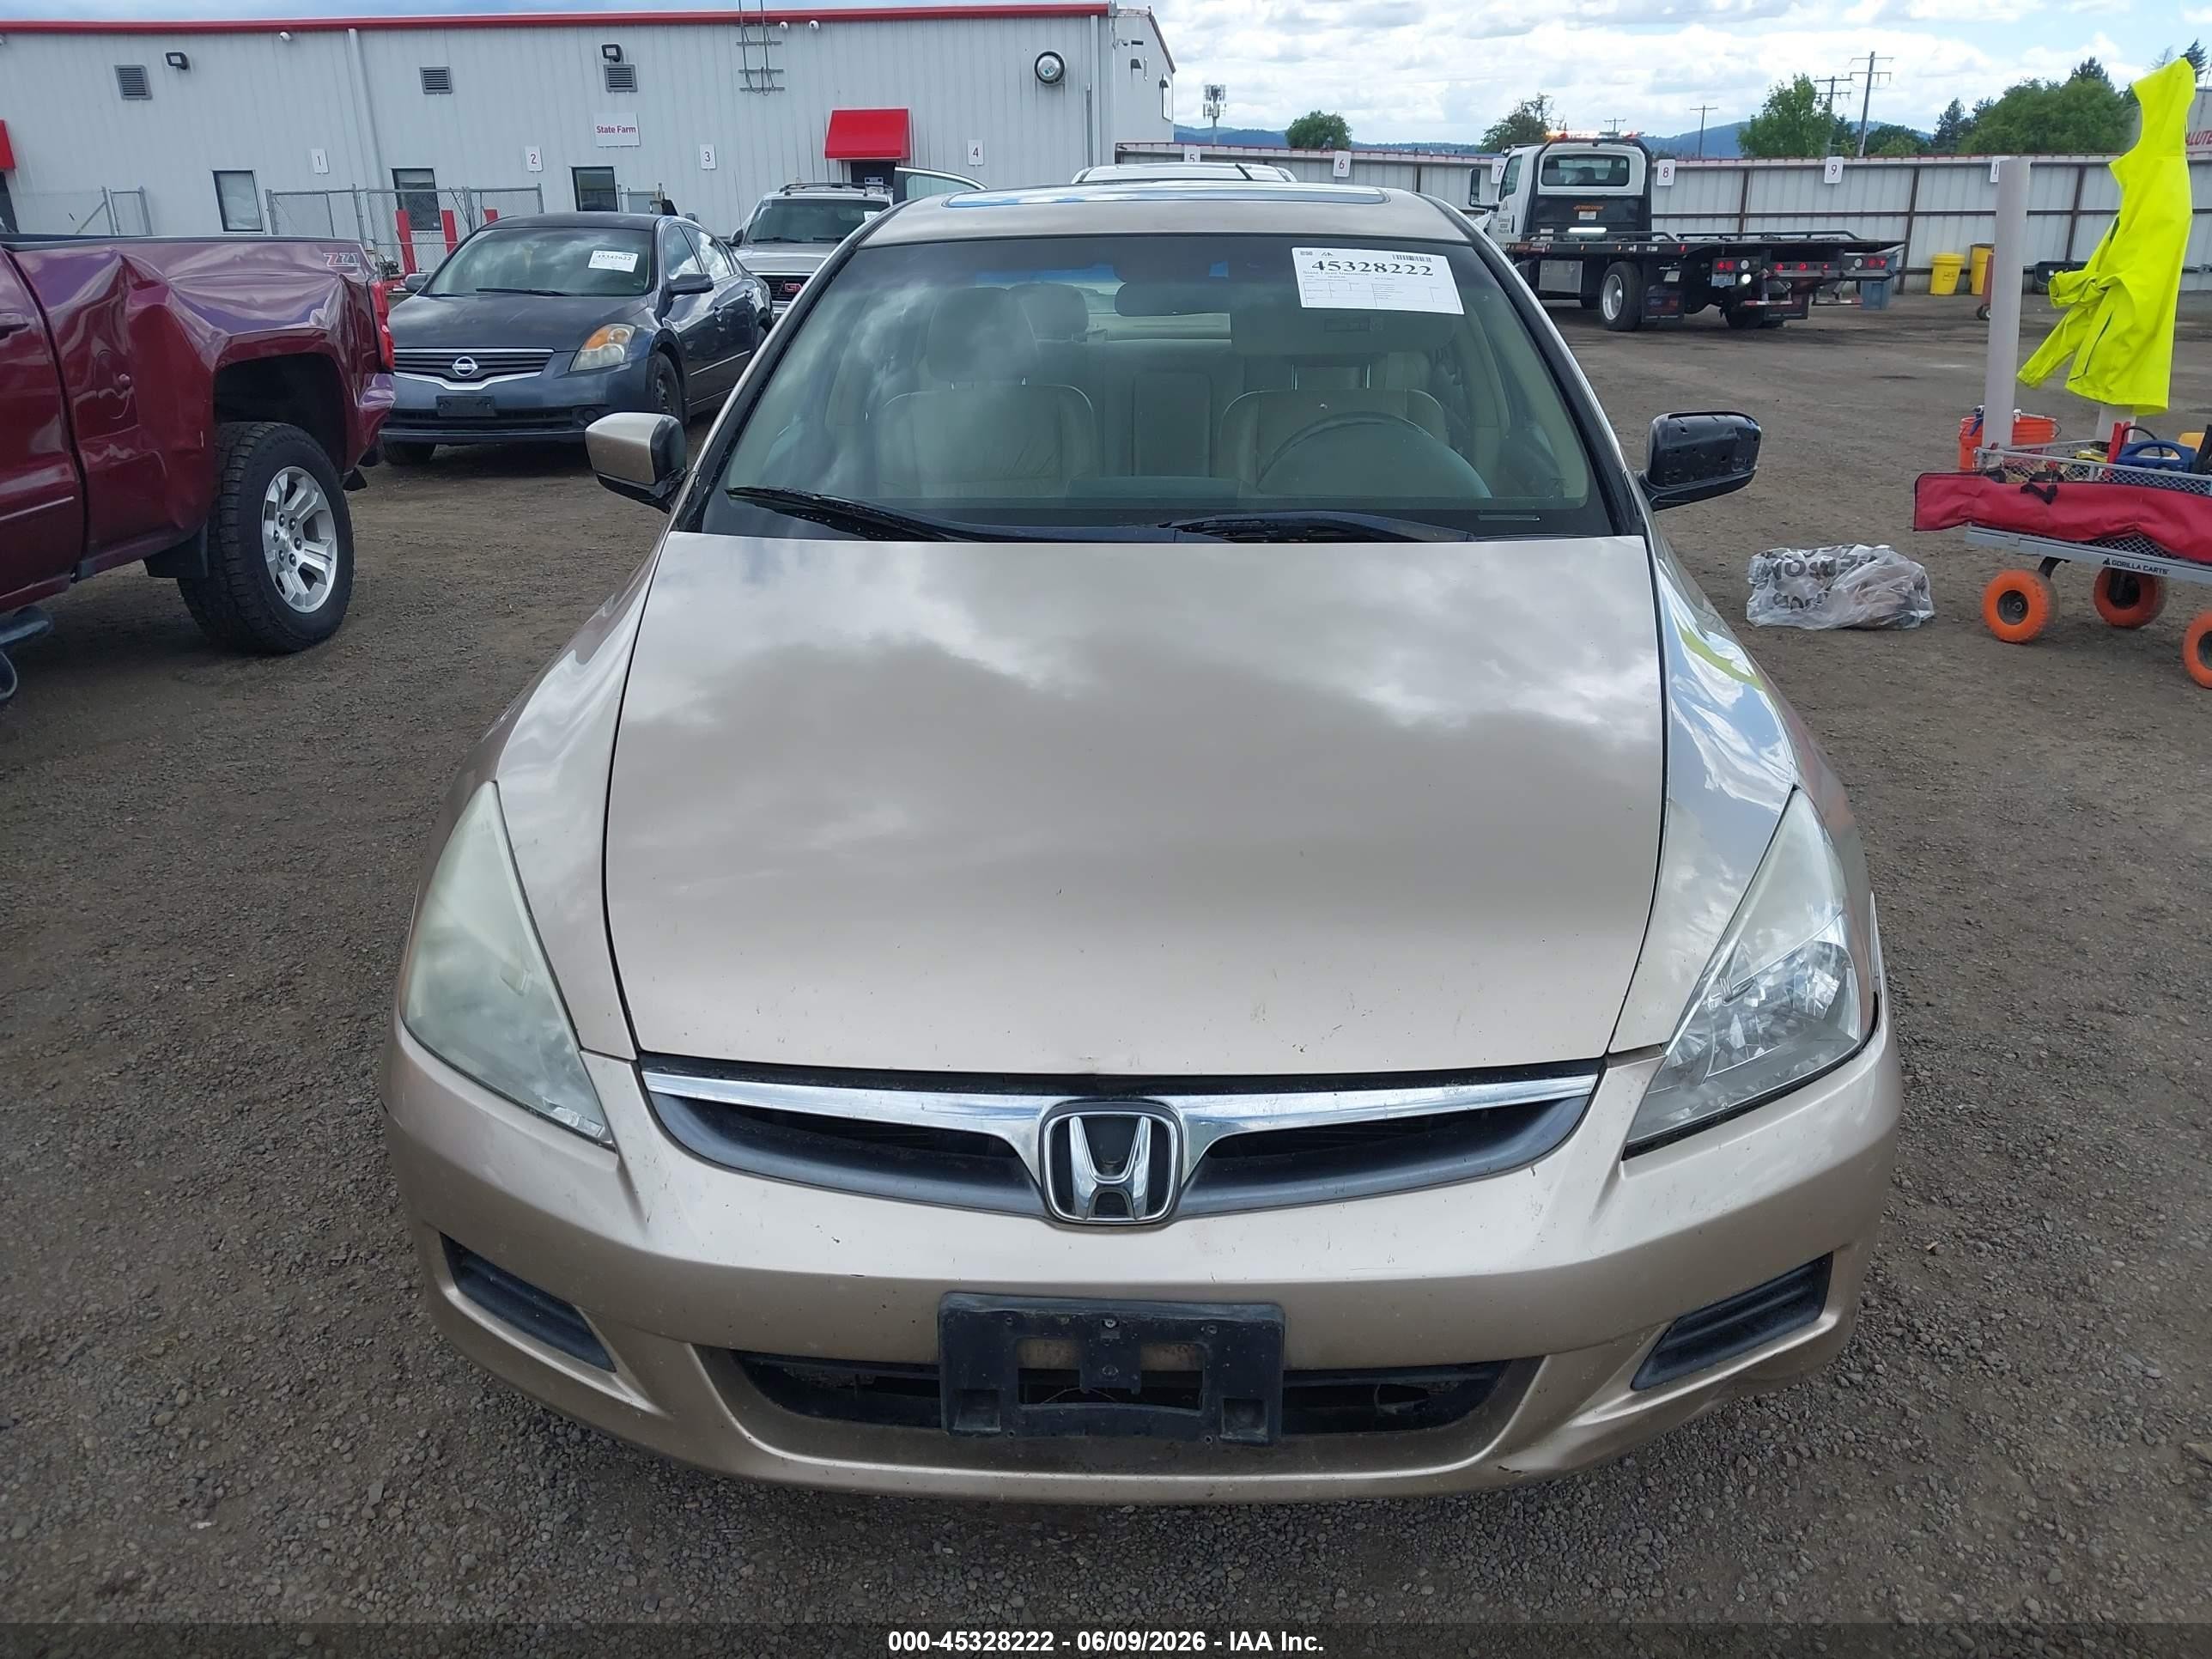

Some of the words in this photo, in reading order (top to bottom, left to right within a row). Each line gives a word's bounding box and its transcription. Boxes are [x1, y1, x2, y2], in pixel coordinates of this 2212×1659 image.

[596, 125, 616, 134] State
[617, 125, 636, 134] Farm
[530, 153, 537, 164] 2
[704, 150, 711, 162] 3
[972, 147, 979, 158] 4
[1189, 153, 1195, 162] 5
[1339, 158, 1345, 170] 6
[1831, 164, 1838, 176] 9
[1497, 165, 1504, 177] 7
[1662, 167, 1669, 179] 8
[1310, 259, 1434, 276] 45328222
[2112, 560, 2142, 570] GORILLA
[2142, 565, 2167, 575] CARTS
